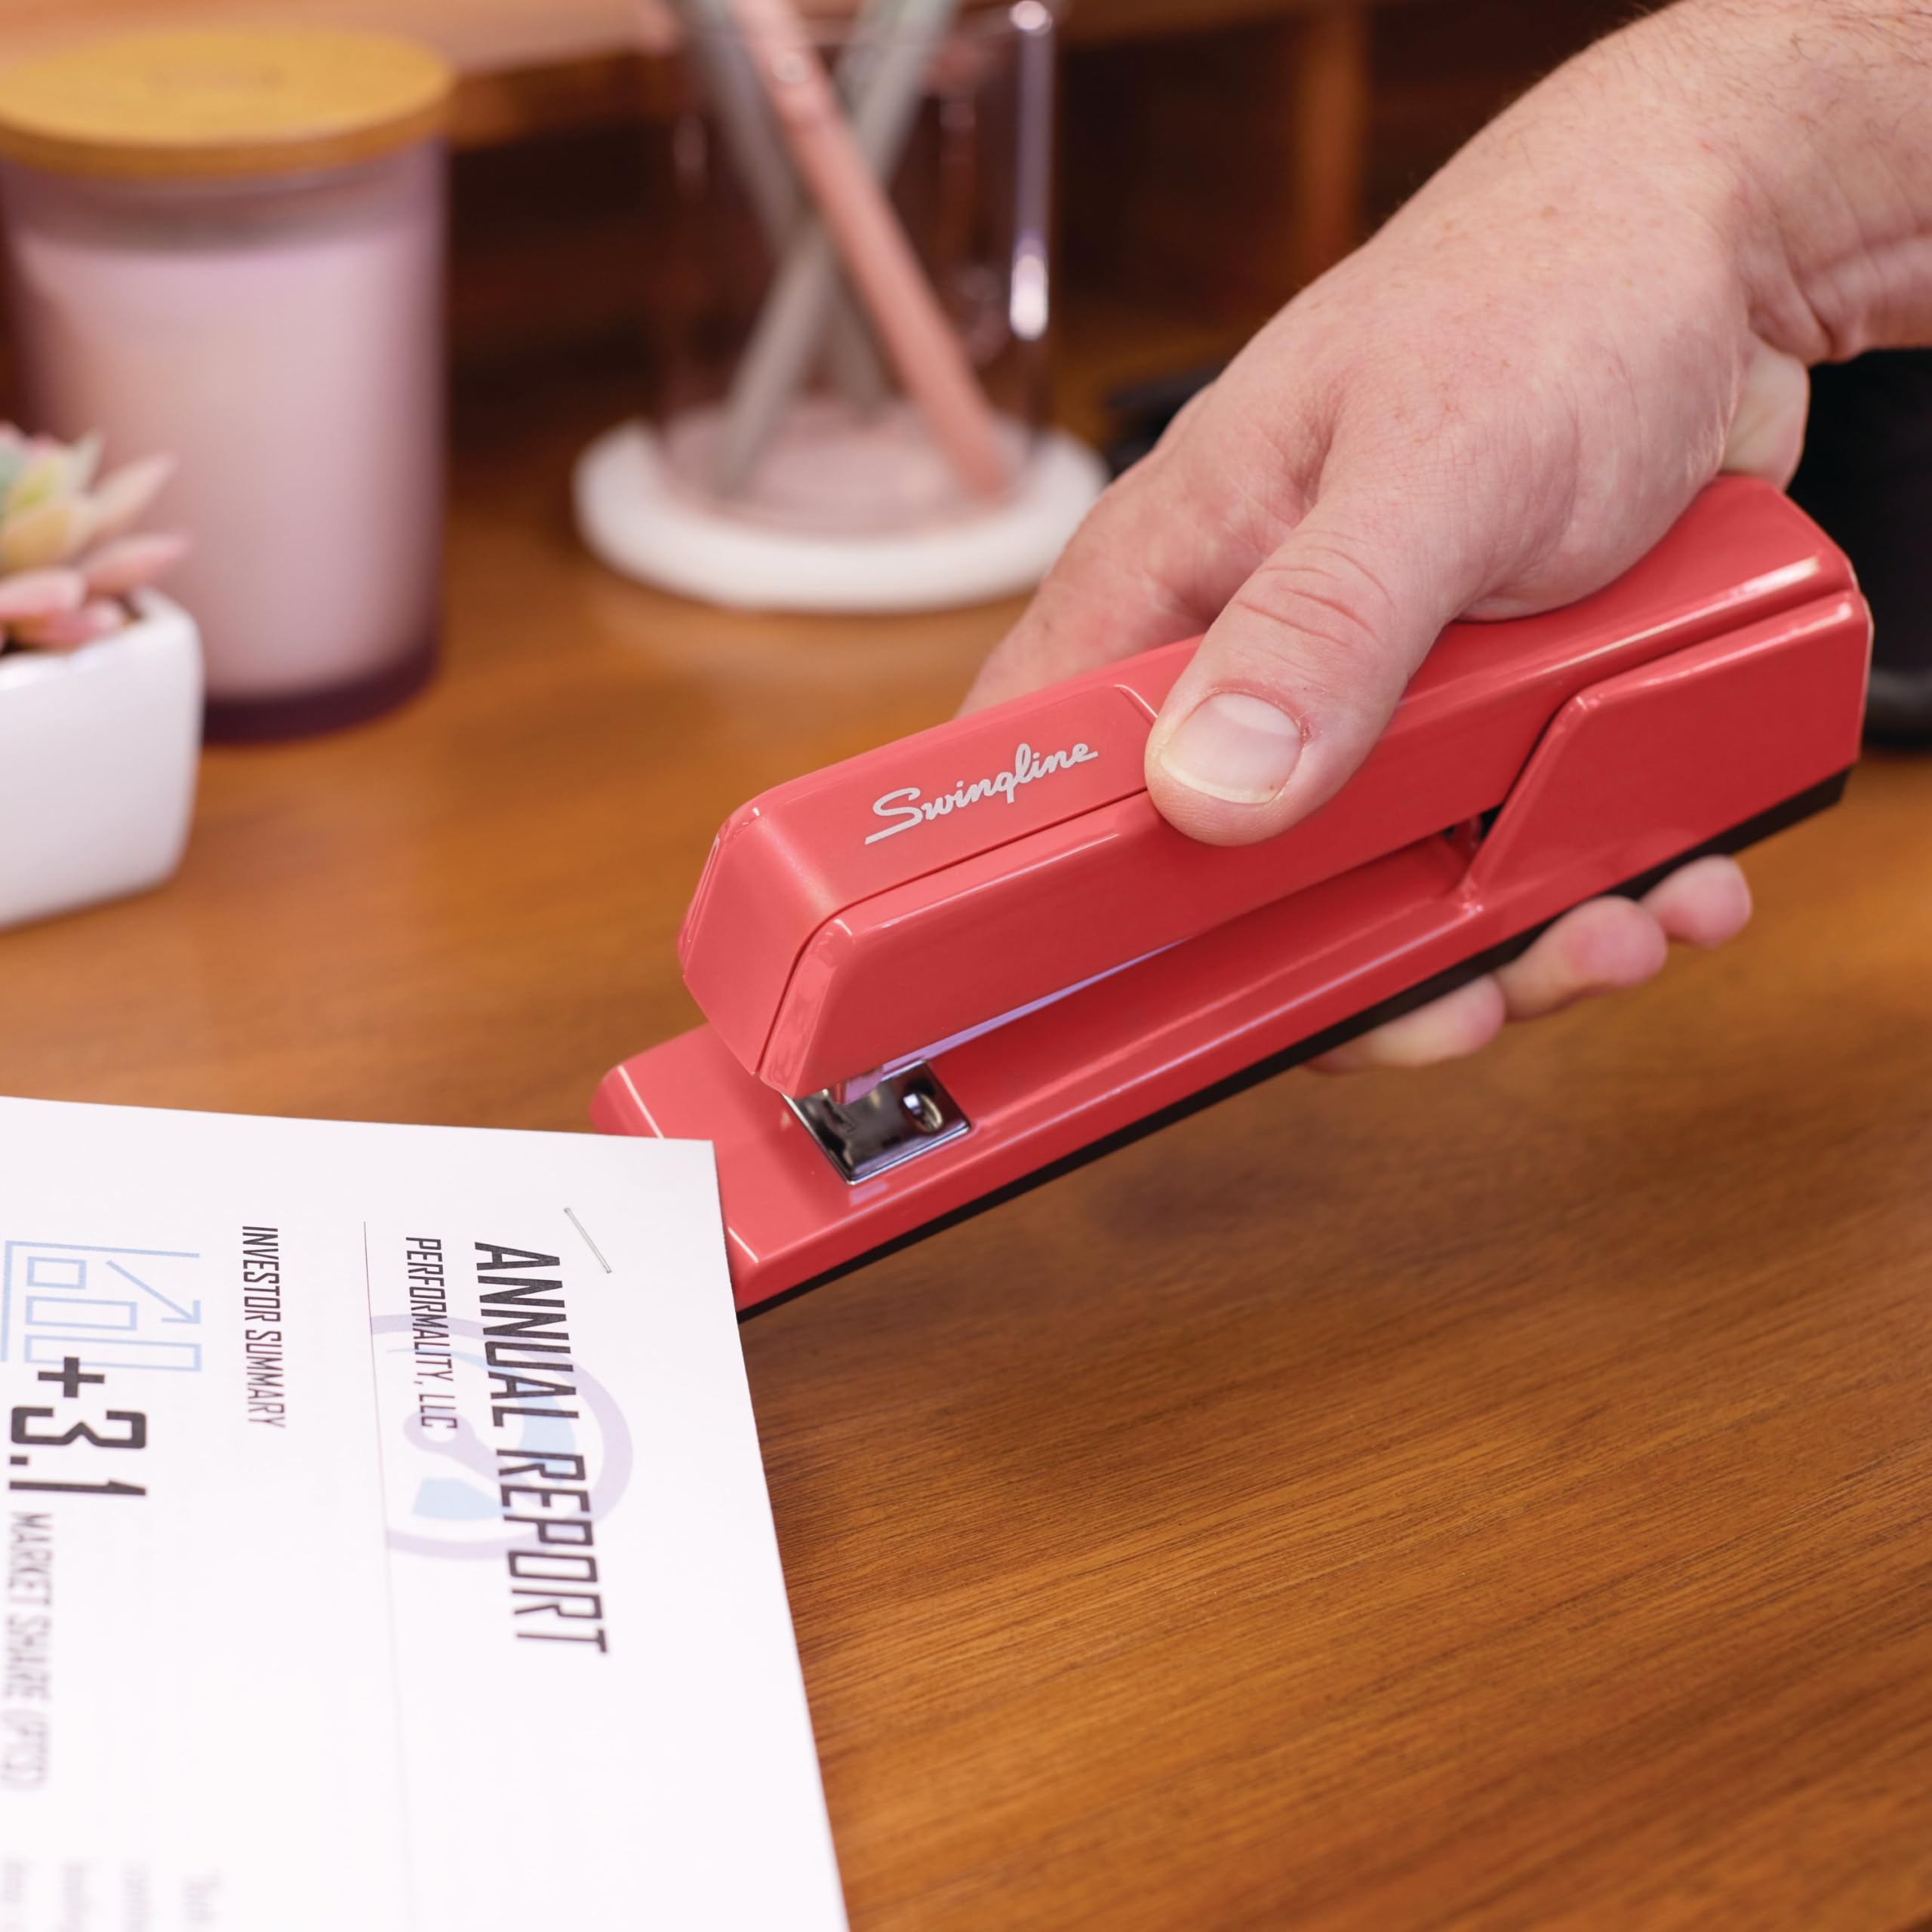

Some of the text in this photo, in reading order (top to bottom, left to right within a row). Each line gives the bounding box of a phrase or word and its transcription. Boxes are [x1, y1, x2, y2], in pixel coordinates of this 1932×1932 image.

[865, 743, 1098, 844] Swingline
[242, 1226, 286, 1429] INVESTOR SUMMARY
[405, 1237, 457, 1429] PERFORMALITY, LLC
[8, 1356, 147, 1496] +3.1
[474, 1241, 607, 1653] ANNUAL REPORT
[8, 1511, 53, 1606] MARKET
[5, 1613, 51, 1700] SHARE
